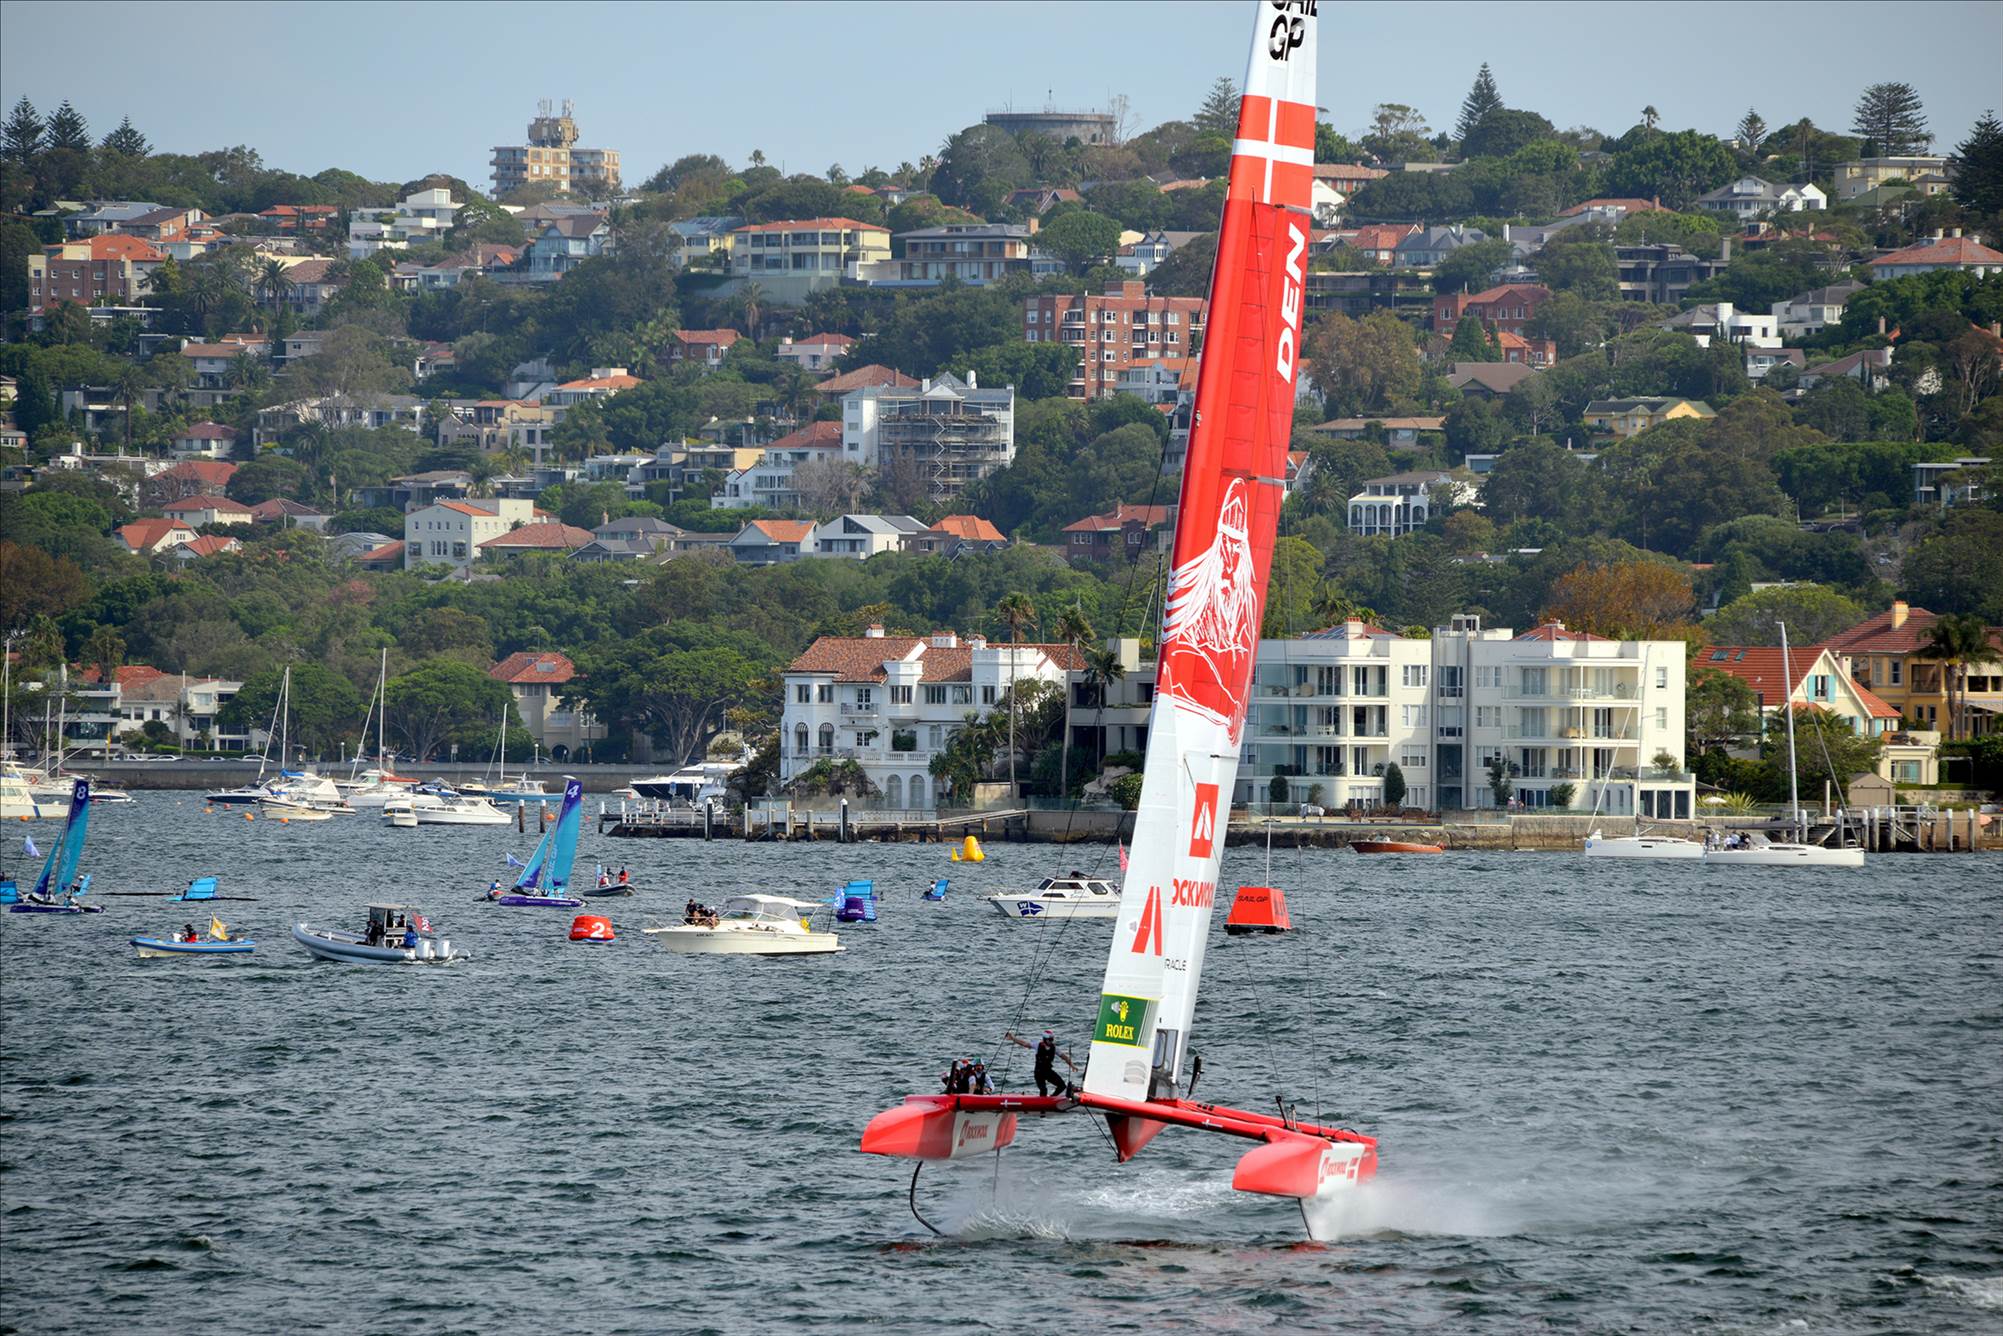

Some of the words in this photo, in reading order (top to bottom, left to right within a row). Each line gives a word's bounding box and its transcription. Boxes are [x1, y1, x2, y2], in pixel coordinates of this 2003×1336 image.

[1268, 14, 1305, 61] GP
[1277, 222, 1305, 384] DEN
[76, 786, 87, 800] 8
[567, 785, 579, 798] 4
[590, 921, 605, 938] 2
[1164, 958, 1187, 971] RACLE
[1105, 1023, 1135, 1040] ROLEX
